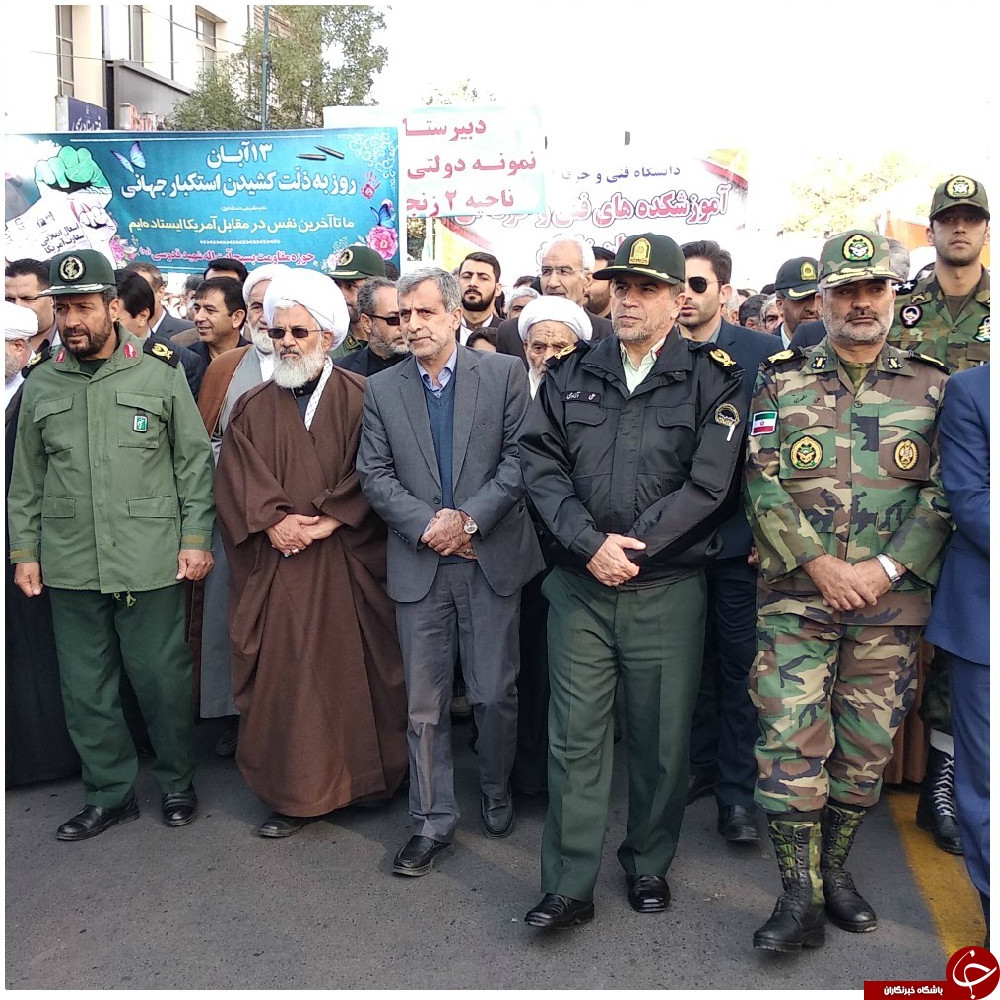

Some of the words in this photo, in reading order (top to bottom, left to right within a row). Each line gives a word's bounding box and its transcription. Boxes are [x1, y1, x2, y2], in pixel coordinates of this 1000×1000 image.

[402, 118, 487, 141] دبیرستا
[407, 154, 466, 179] دولتی
[473, 151, 537, 176] نمونه
[121, 173, 168, 199] جهانی
[169, 172, 221, 199] استکبار
[223, 170, 277, 198] کشیدن
[312, 176, 330, 196] به
[331, 175, 358, 197] روز
[406, 192, 440, 217] زنج
[465, 188, 514, 214] ناحیه
[591, 192, 634, 228] های
[634, 184, 734, 225] آموزشکده
[184, 214, 217, 234] آمریکا
[217, 217, 249, 234] مقابل
[250, 220, 266, 234] در
[267, 217, 298, 234] نفس
[298, 213, 333, 233] آخرین
